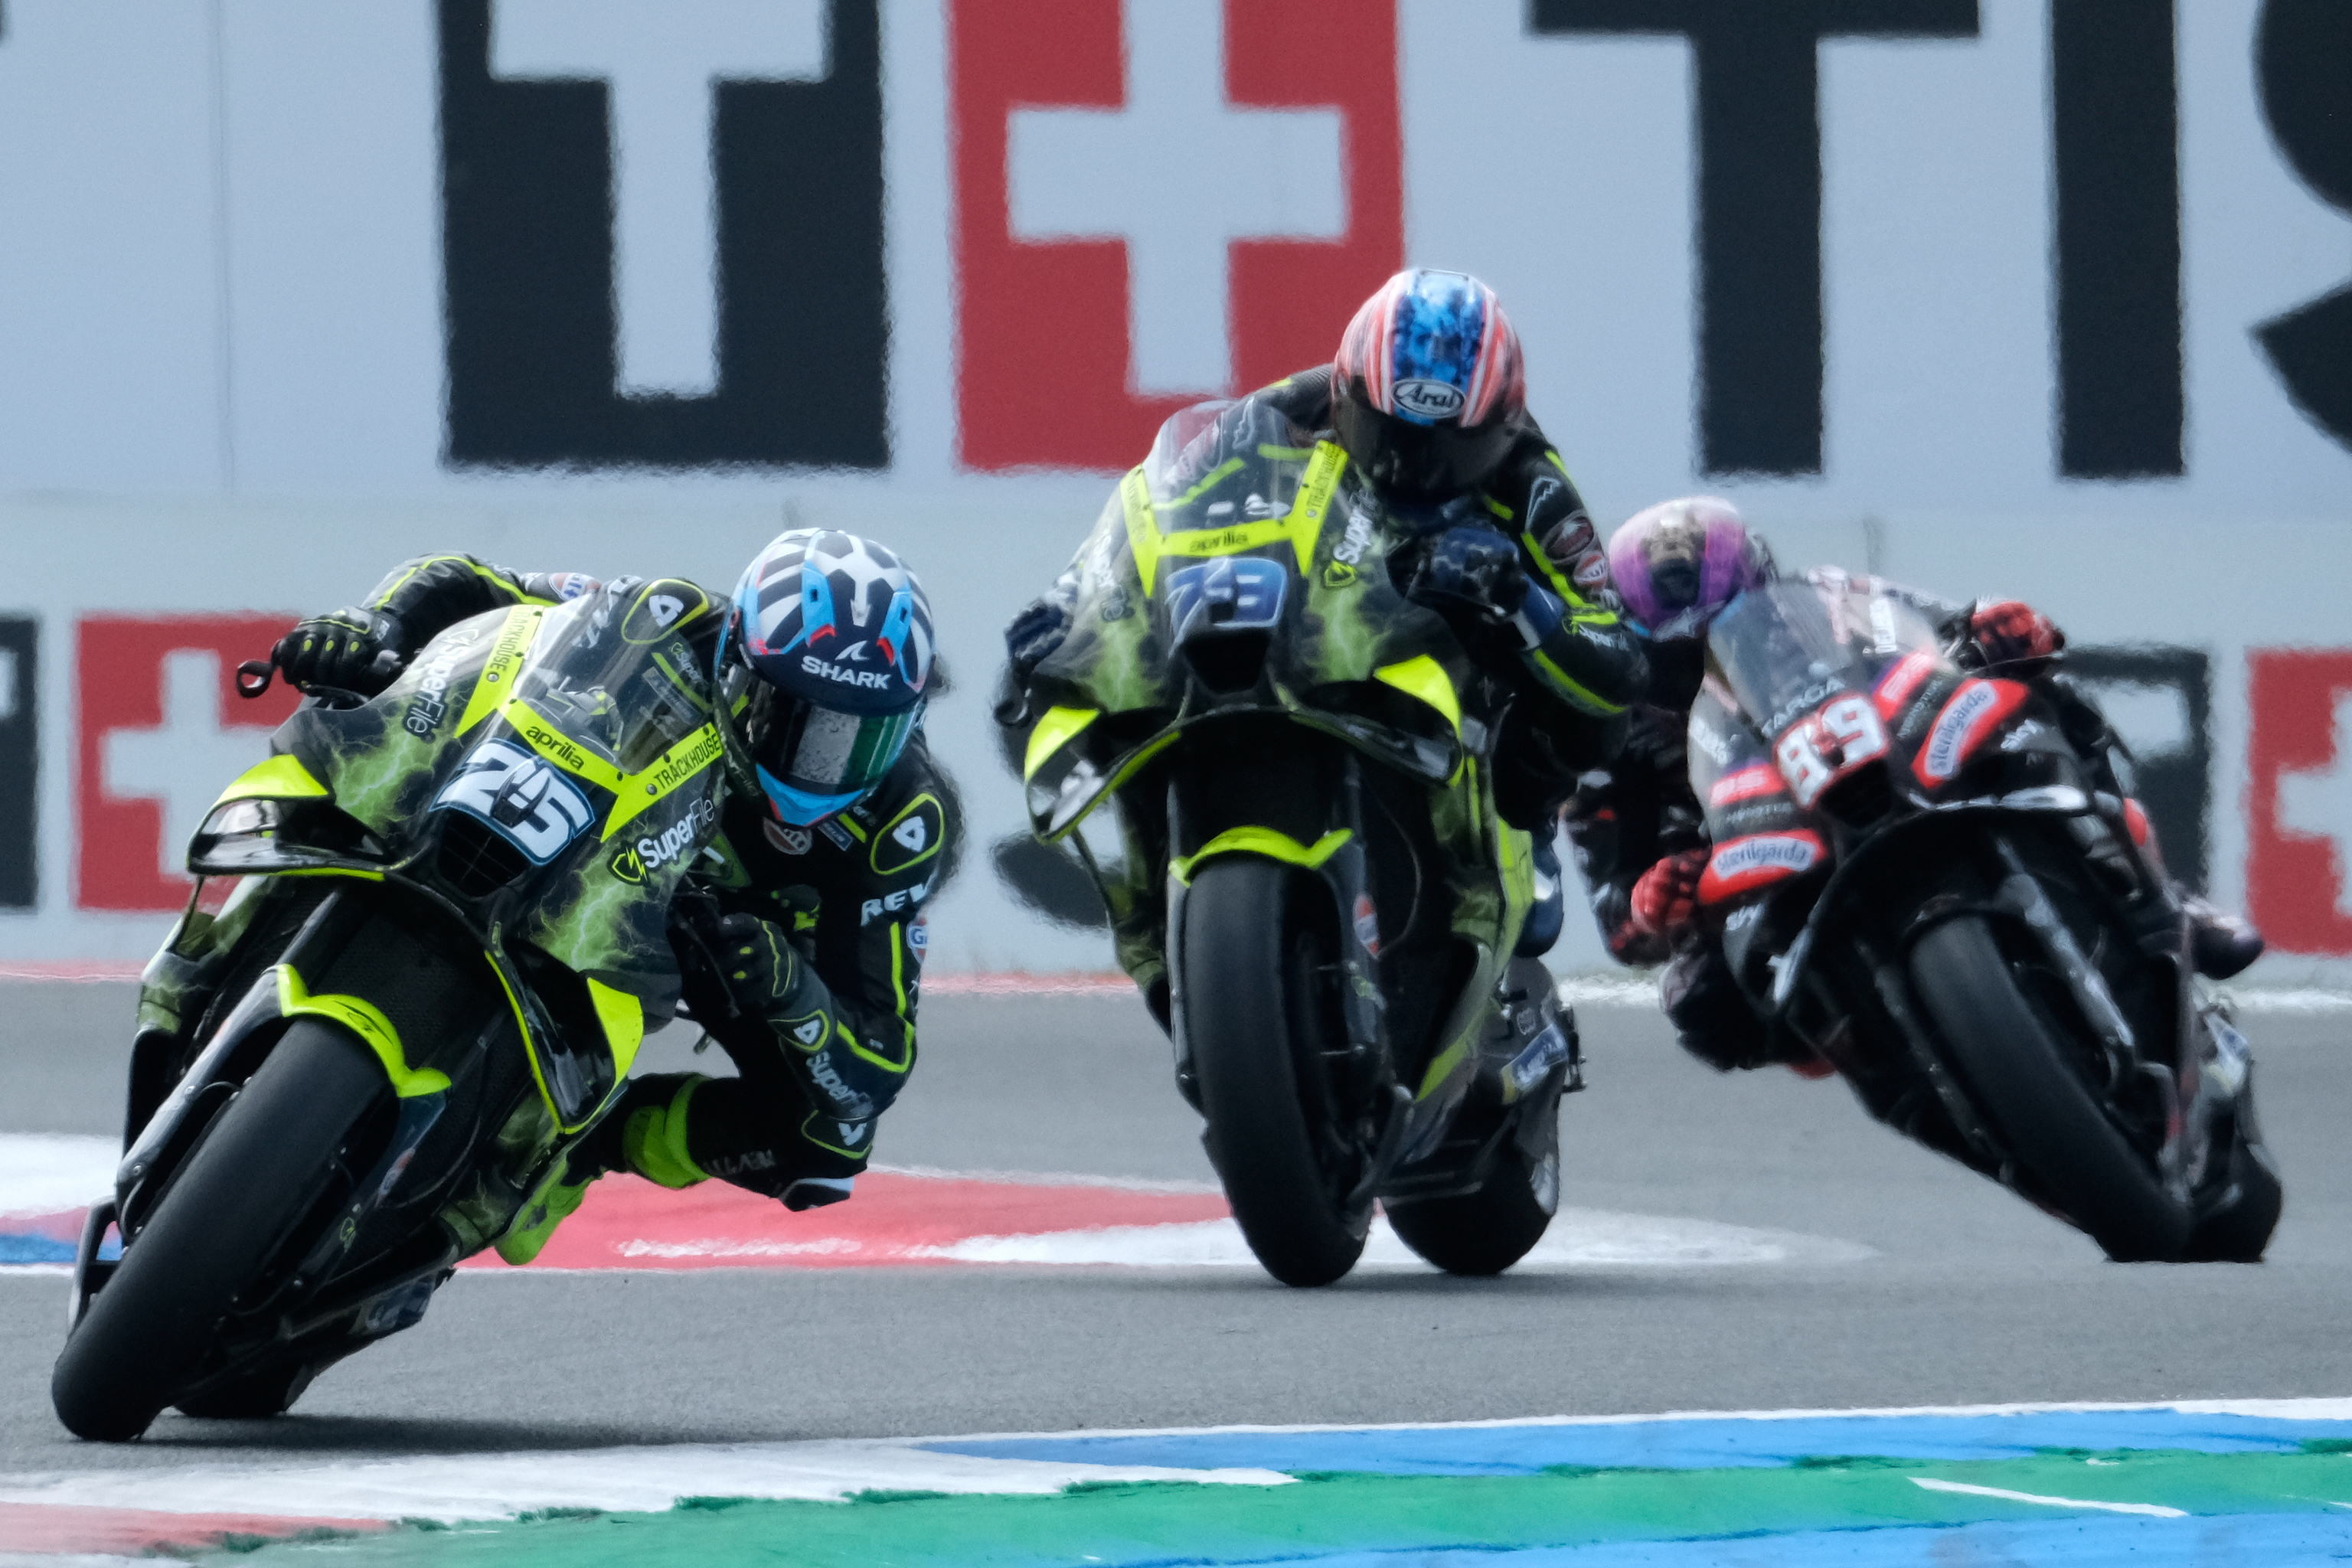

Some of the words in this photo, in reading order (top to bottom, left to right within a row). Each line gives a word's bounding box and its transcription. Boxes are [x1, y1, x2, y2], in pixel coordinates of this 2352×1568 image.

[1526, 0, 2352, 479] TI
[1397, 383, 1457, 408] Arai
[407, 644, 469, 733] SuperFile
[801, 655, 891, 689] SHARK
[525, 726, 585, 771] aprilia
[653, 733, 721, 790] TRACKHOUSE
[1777, 697, 1883, 805] 89
[430, 739, 595, 864] 25
[637, 797, 714, 867] SuperFile
